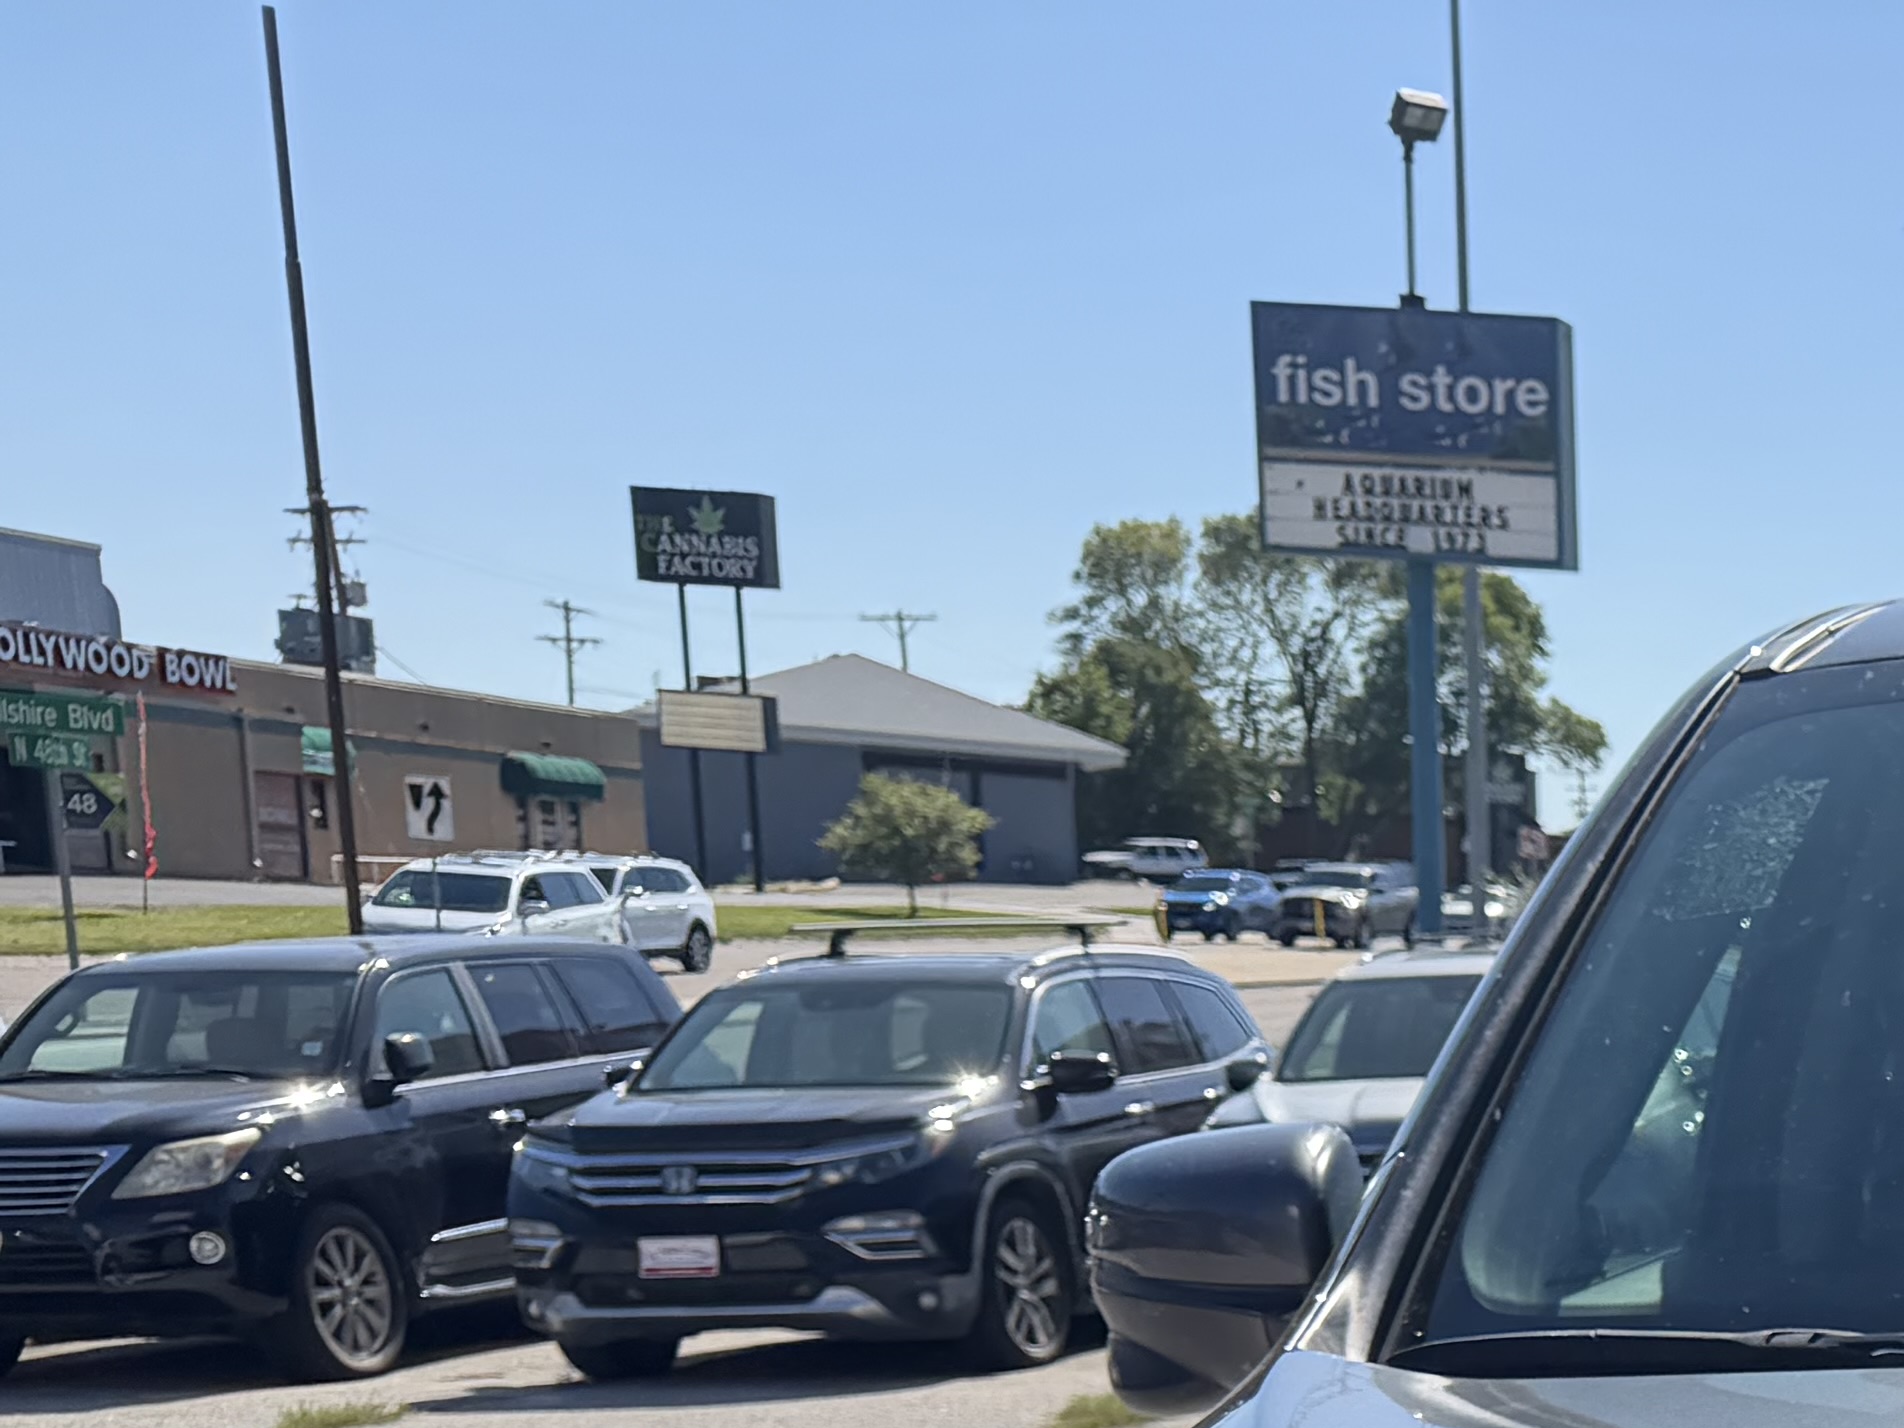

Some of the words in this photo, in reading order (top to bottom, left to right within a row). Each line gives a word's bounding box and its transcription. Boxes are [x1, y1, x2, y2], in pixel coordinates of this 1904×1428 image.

[1270, 353, 1380, 409] fish
[1399, 364, 1551, 417] store
[1341, 472, 1475, 503] AQUARIUM
[1312, 495, 1511, 530] HEADQUARTERS
[640, 532, 760, 558] CANNABIS
[1336, 523, 1404, 547] SINCE
[657, 554, 758, 579] FACTORY
[165, 652, 238, 691] BOWL
[67, 703, 115, 733] Blvd
[13, 736, 28, 763] N
[67, 792, 98, 814] 48
